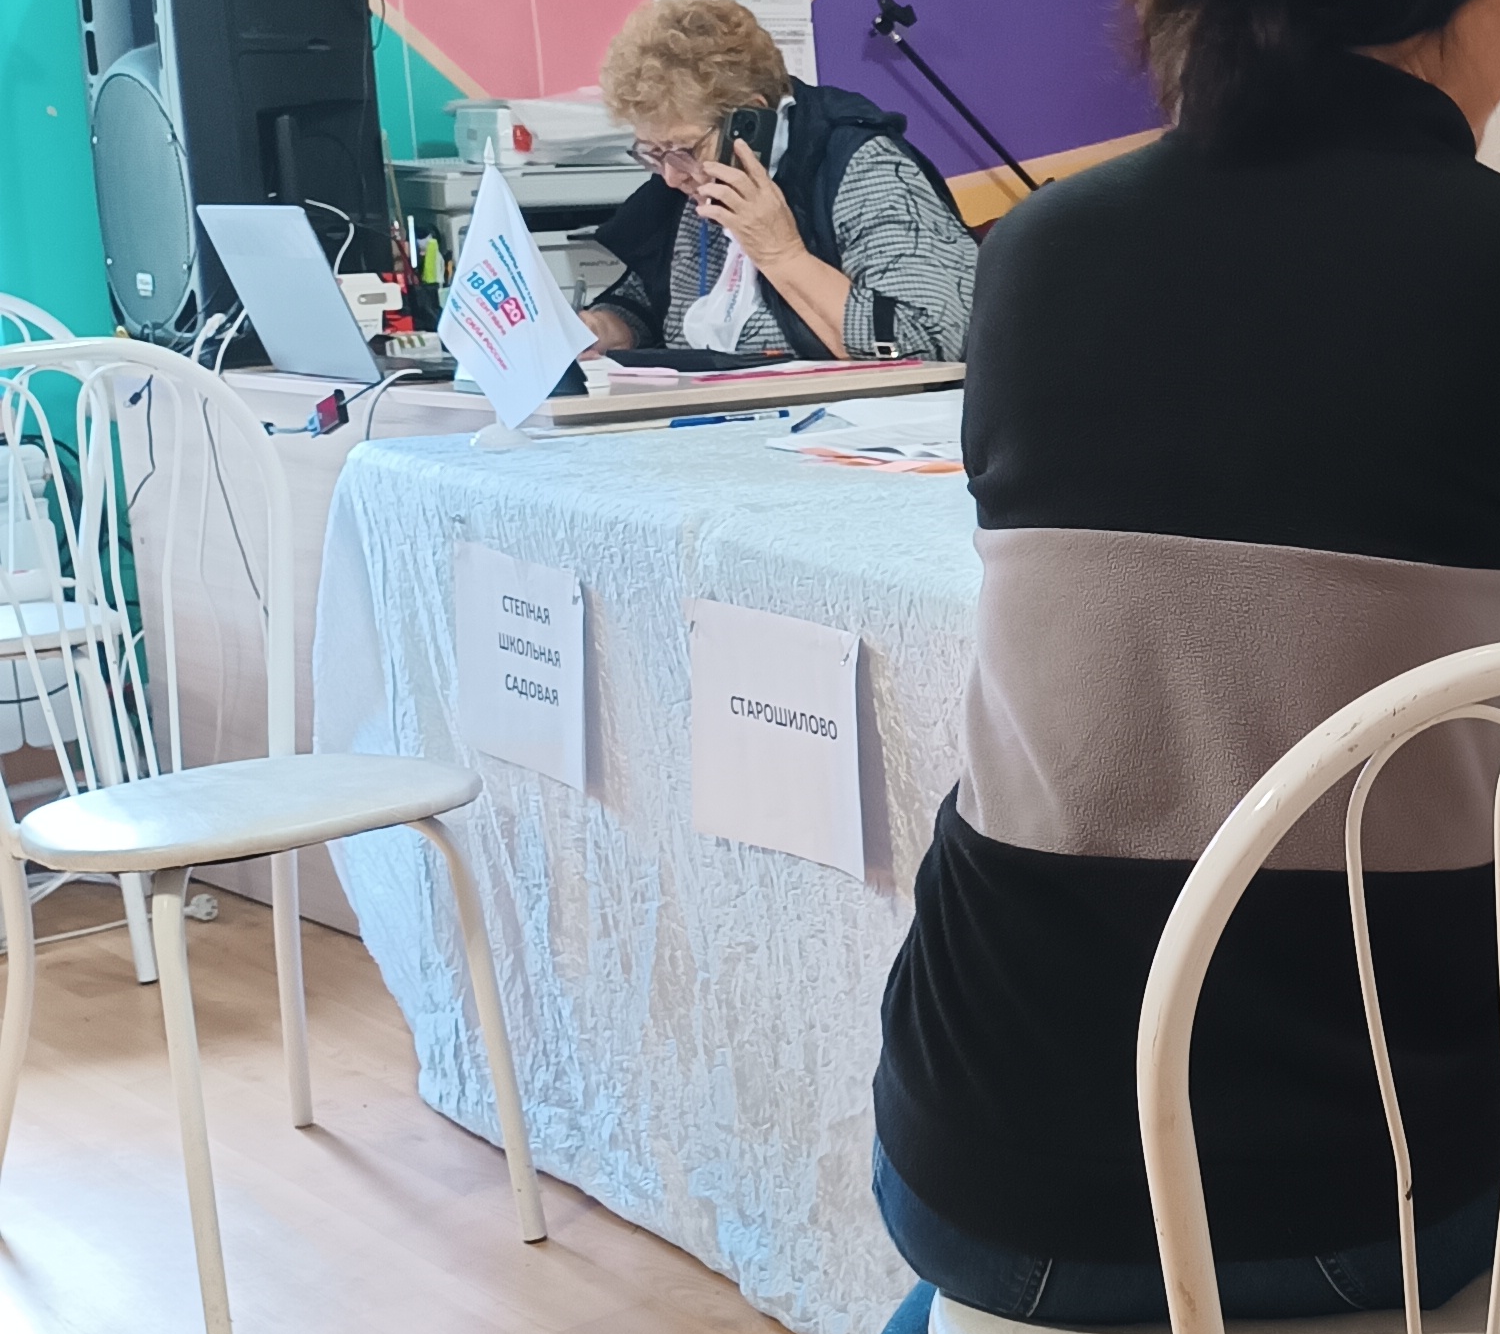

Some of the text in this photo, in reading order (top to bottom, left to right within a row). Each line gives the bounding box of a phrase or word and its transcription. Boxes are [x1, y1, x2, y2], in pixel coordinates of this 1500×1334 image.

[467, 271, 522, 322] 18 19 20
[502, 594, 550, 625] СТЕПНАЯ
[498, 632, 561, 668] ШКОЛЬНАЯ
[504, 673, 559, 706] САДОВАЯ
[730, 695, 838, 740] СТАРОШИЛОВО
